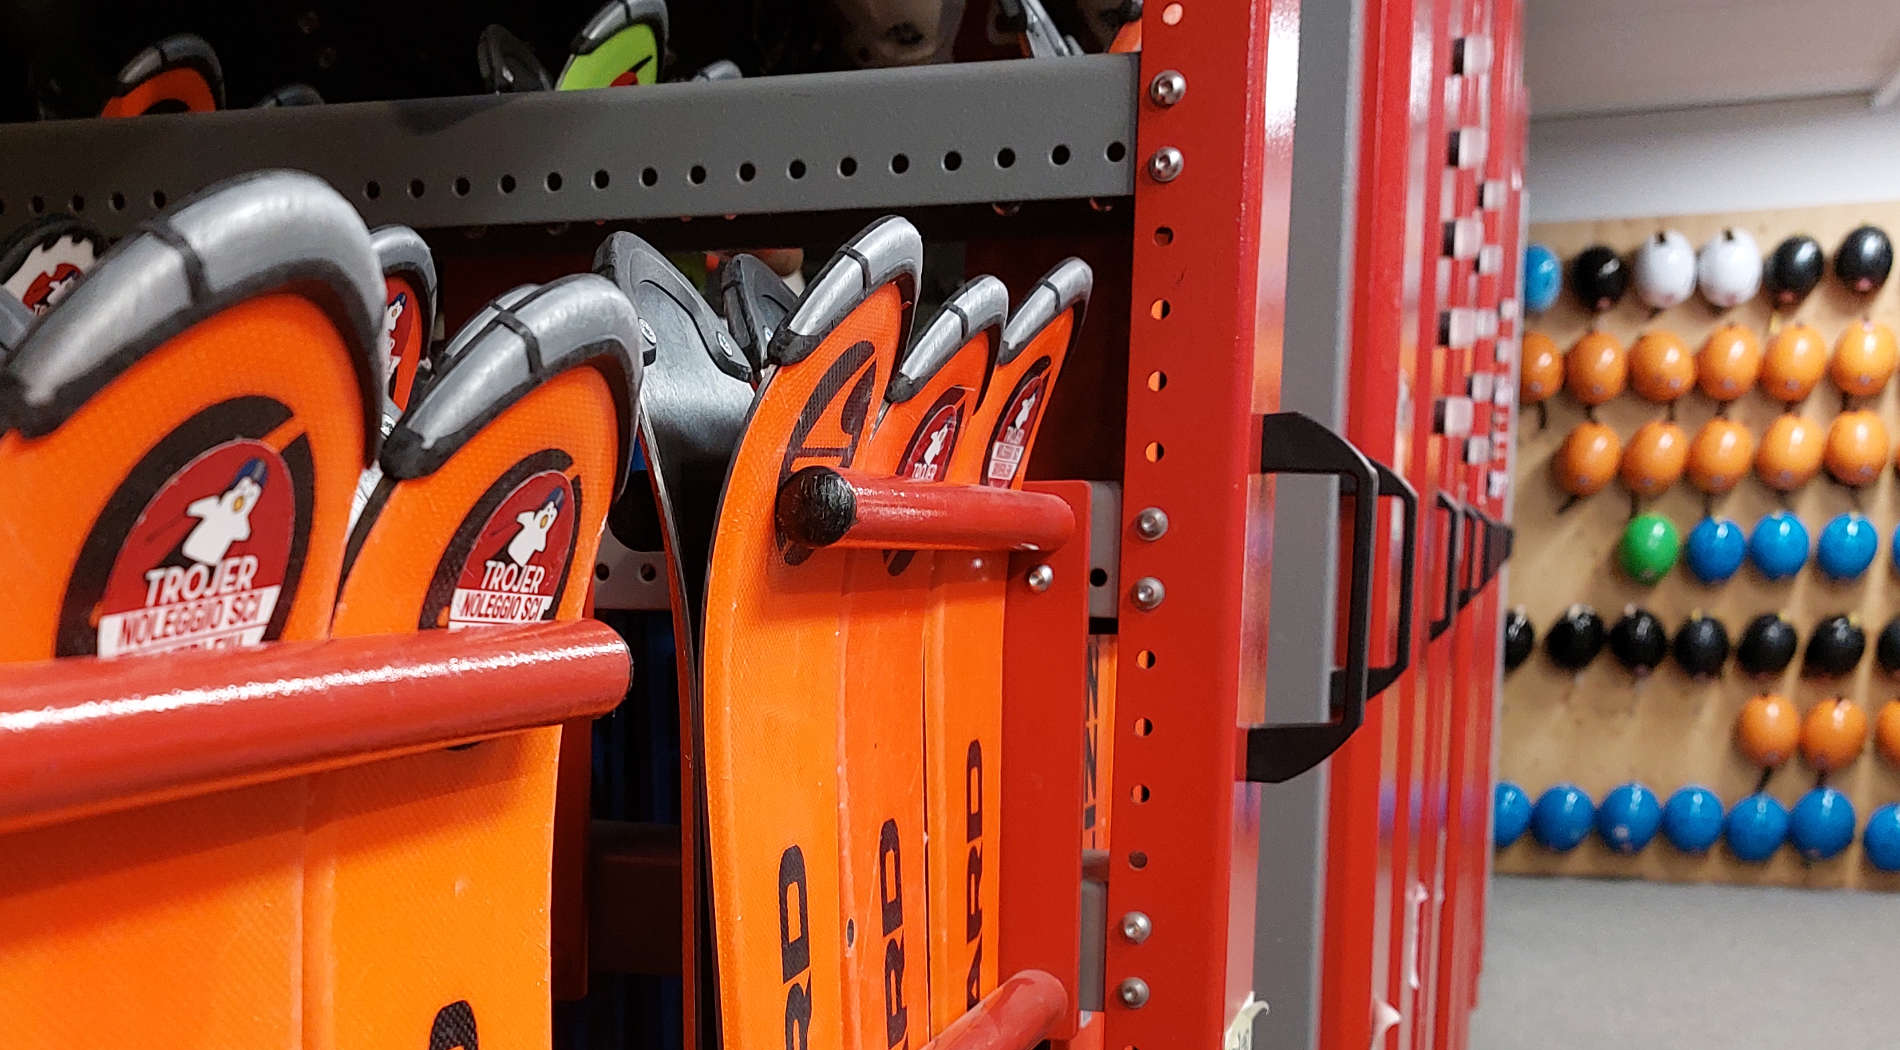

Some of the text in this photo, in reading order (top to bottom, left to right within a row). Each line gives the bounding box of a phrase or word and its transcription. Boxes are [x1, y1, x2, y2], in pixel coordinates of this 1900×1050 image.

[145, 555, 258, 608] TROJER
[480, 560, 545, 593] TROJER
[117, 601, 224, 648] NOLEGGIO
[227, 593, 262, 625] SCI
[460, 592, 543, 621] NOLEGGIO SCI
